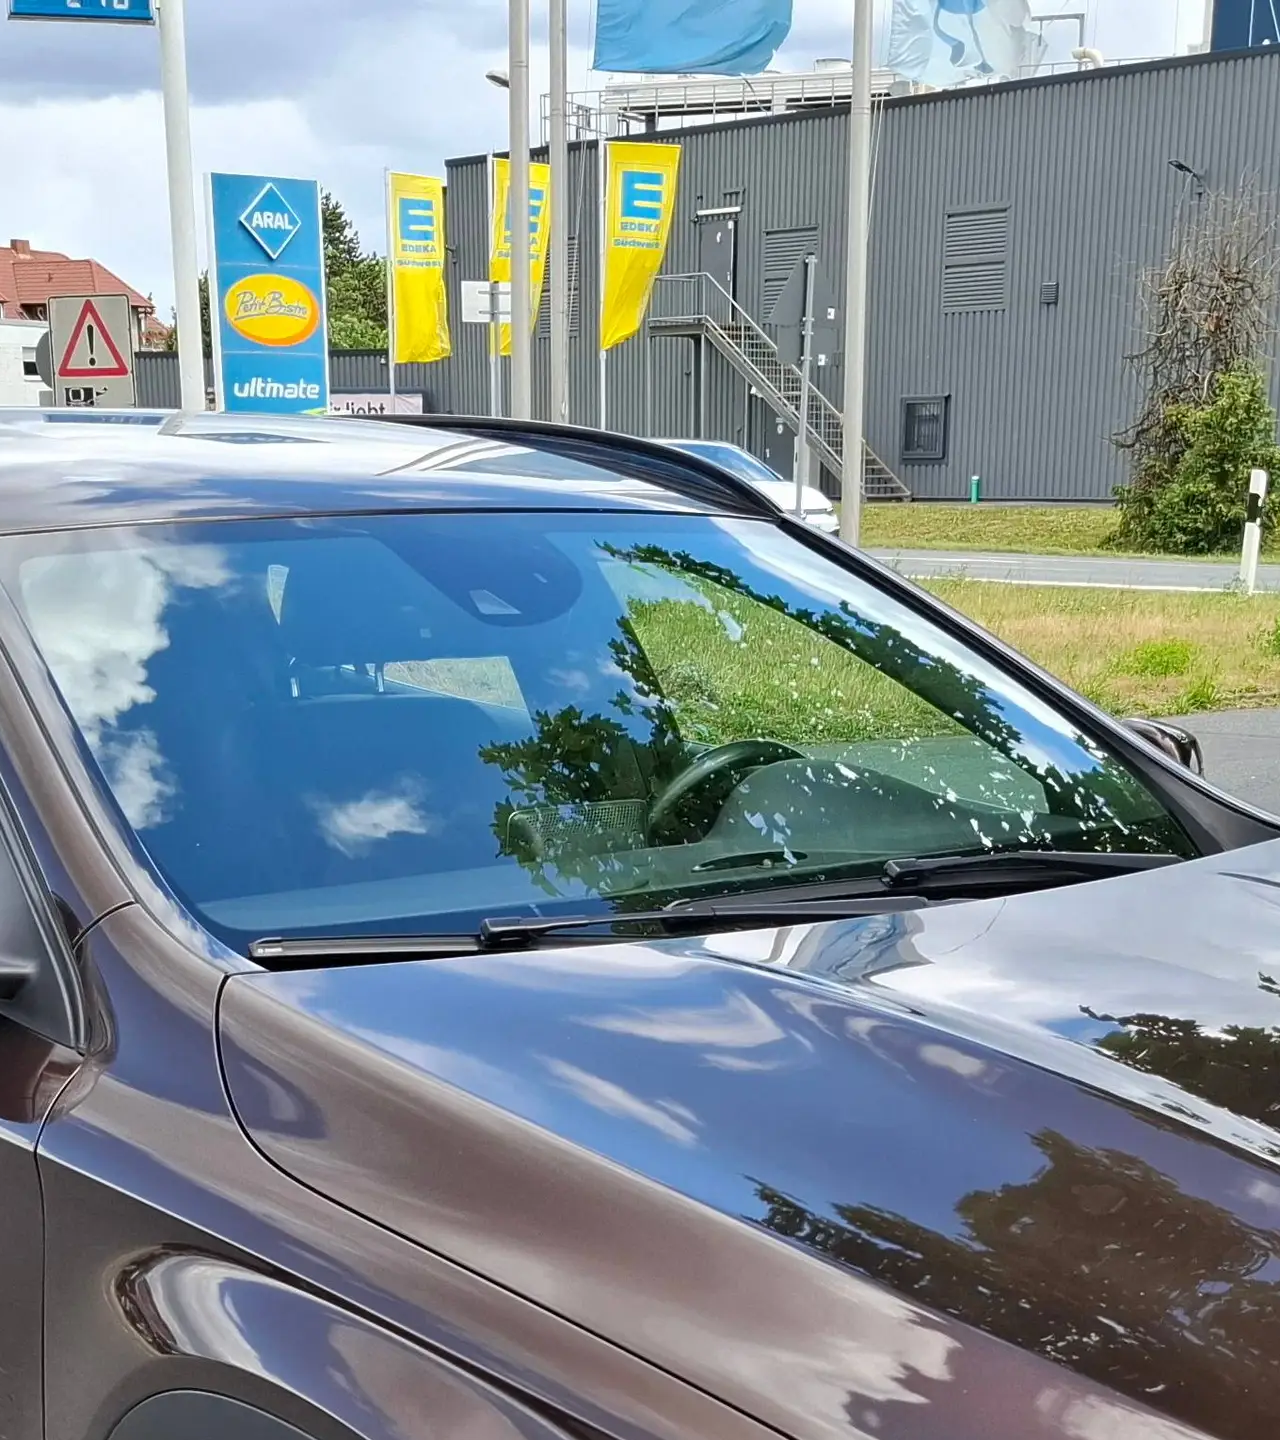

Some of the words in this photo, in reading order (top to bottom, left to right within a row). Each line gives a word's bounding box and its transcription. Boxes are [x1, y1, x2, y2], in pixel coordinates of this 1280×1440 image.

[251, 211, 294, 230] ARAL
[620, 222, 660, 232] EDEKA
[401, 243, 436, 253] EDEKA
[233, 377, 320, 399] ultimate
